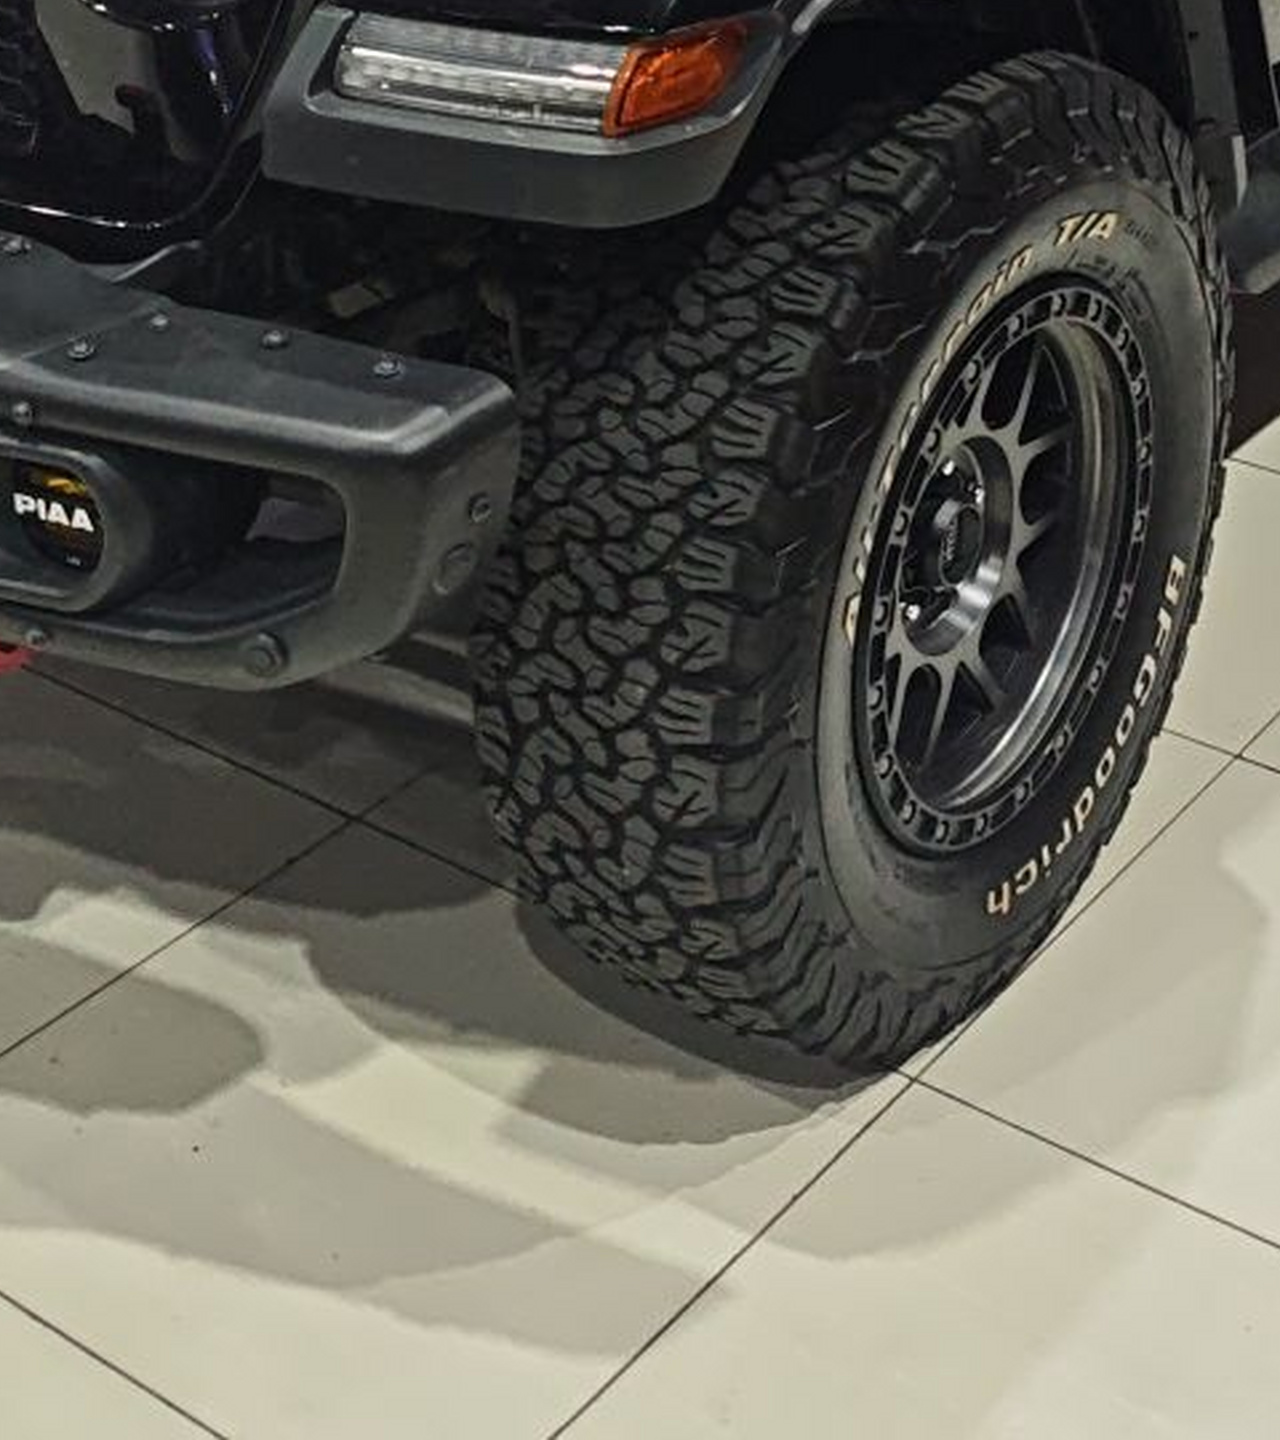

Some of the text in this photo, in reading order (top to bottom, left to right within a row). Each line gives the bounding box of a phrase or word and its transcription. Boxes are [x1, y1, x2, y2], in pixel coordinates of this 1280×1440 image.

[1053, 211, 1119, 248] T/A
[12, 491, 95, 533] PIAA
[986, 553, 1187, 917] BFGoodrich
